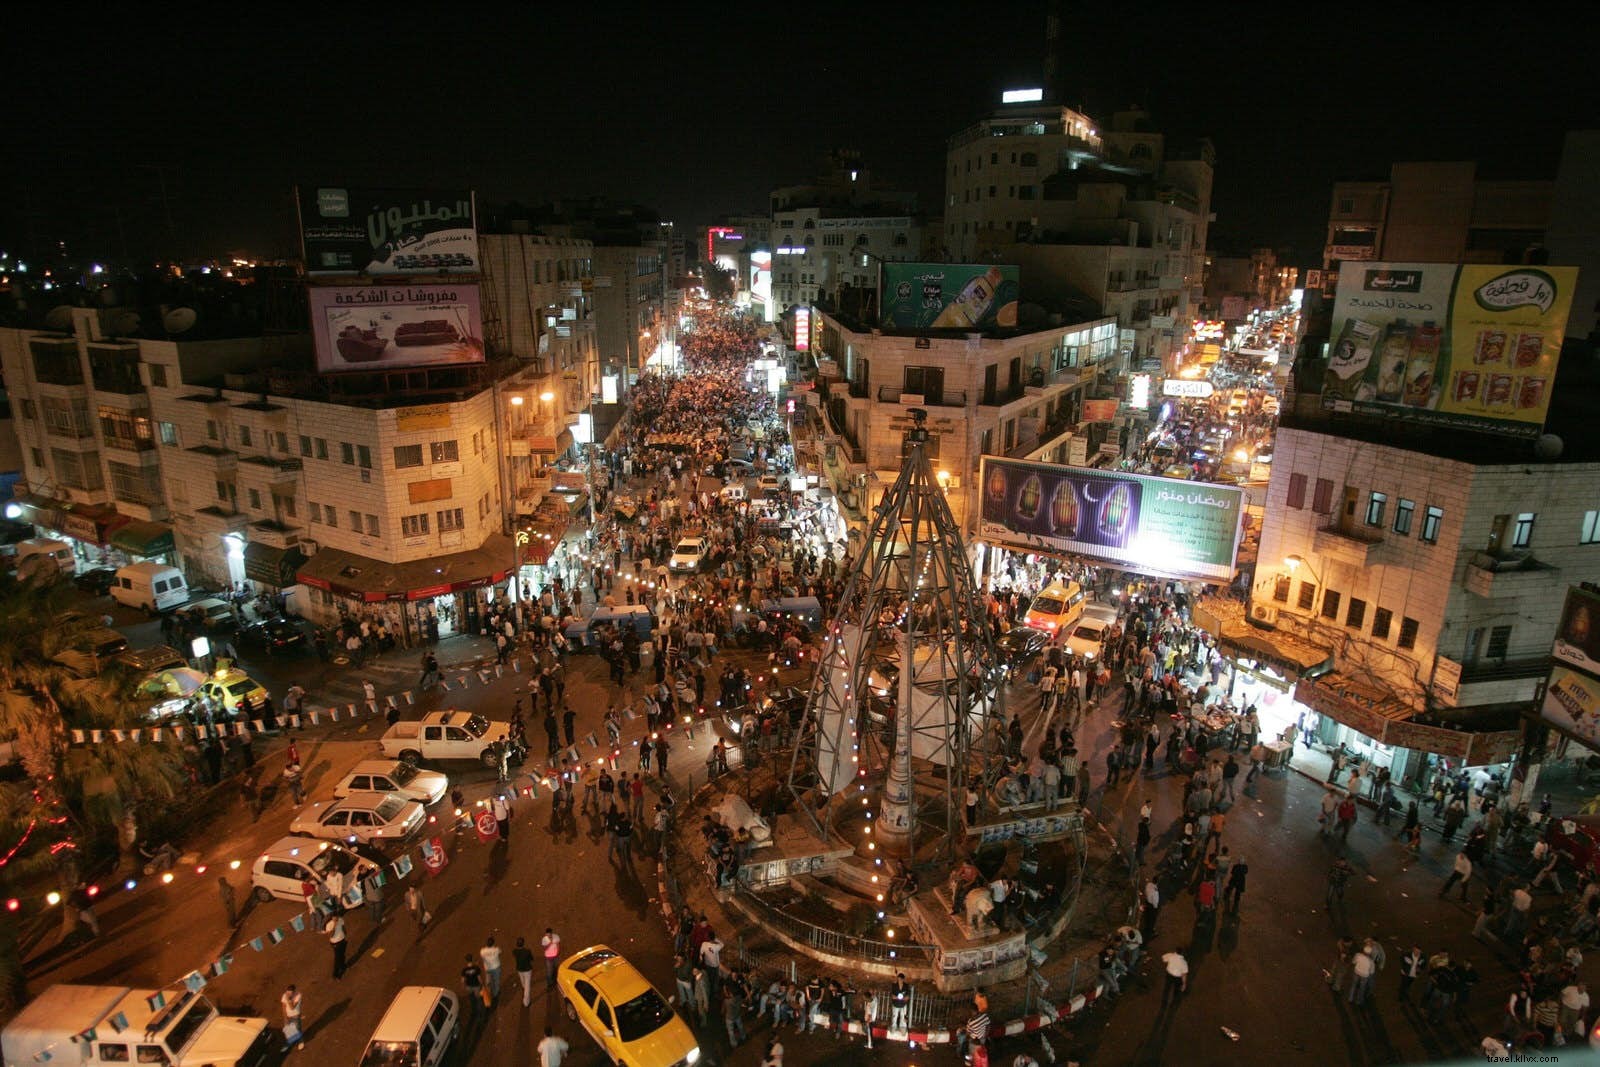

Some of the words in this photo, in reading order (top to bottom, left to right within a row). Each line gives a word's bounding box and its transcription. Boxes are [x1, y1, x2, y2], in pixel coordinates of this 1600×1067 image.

[367, 199, 470, 249] المليون
[1370, 273, 1416, 289] الربيع
[393, 288, 458, 304] مفروشات
[1349, 296, 1395, 311] للجميع
[1187, 493, 1231, 510] رمضان
[983, 525, 1006, 535] جوال
